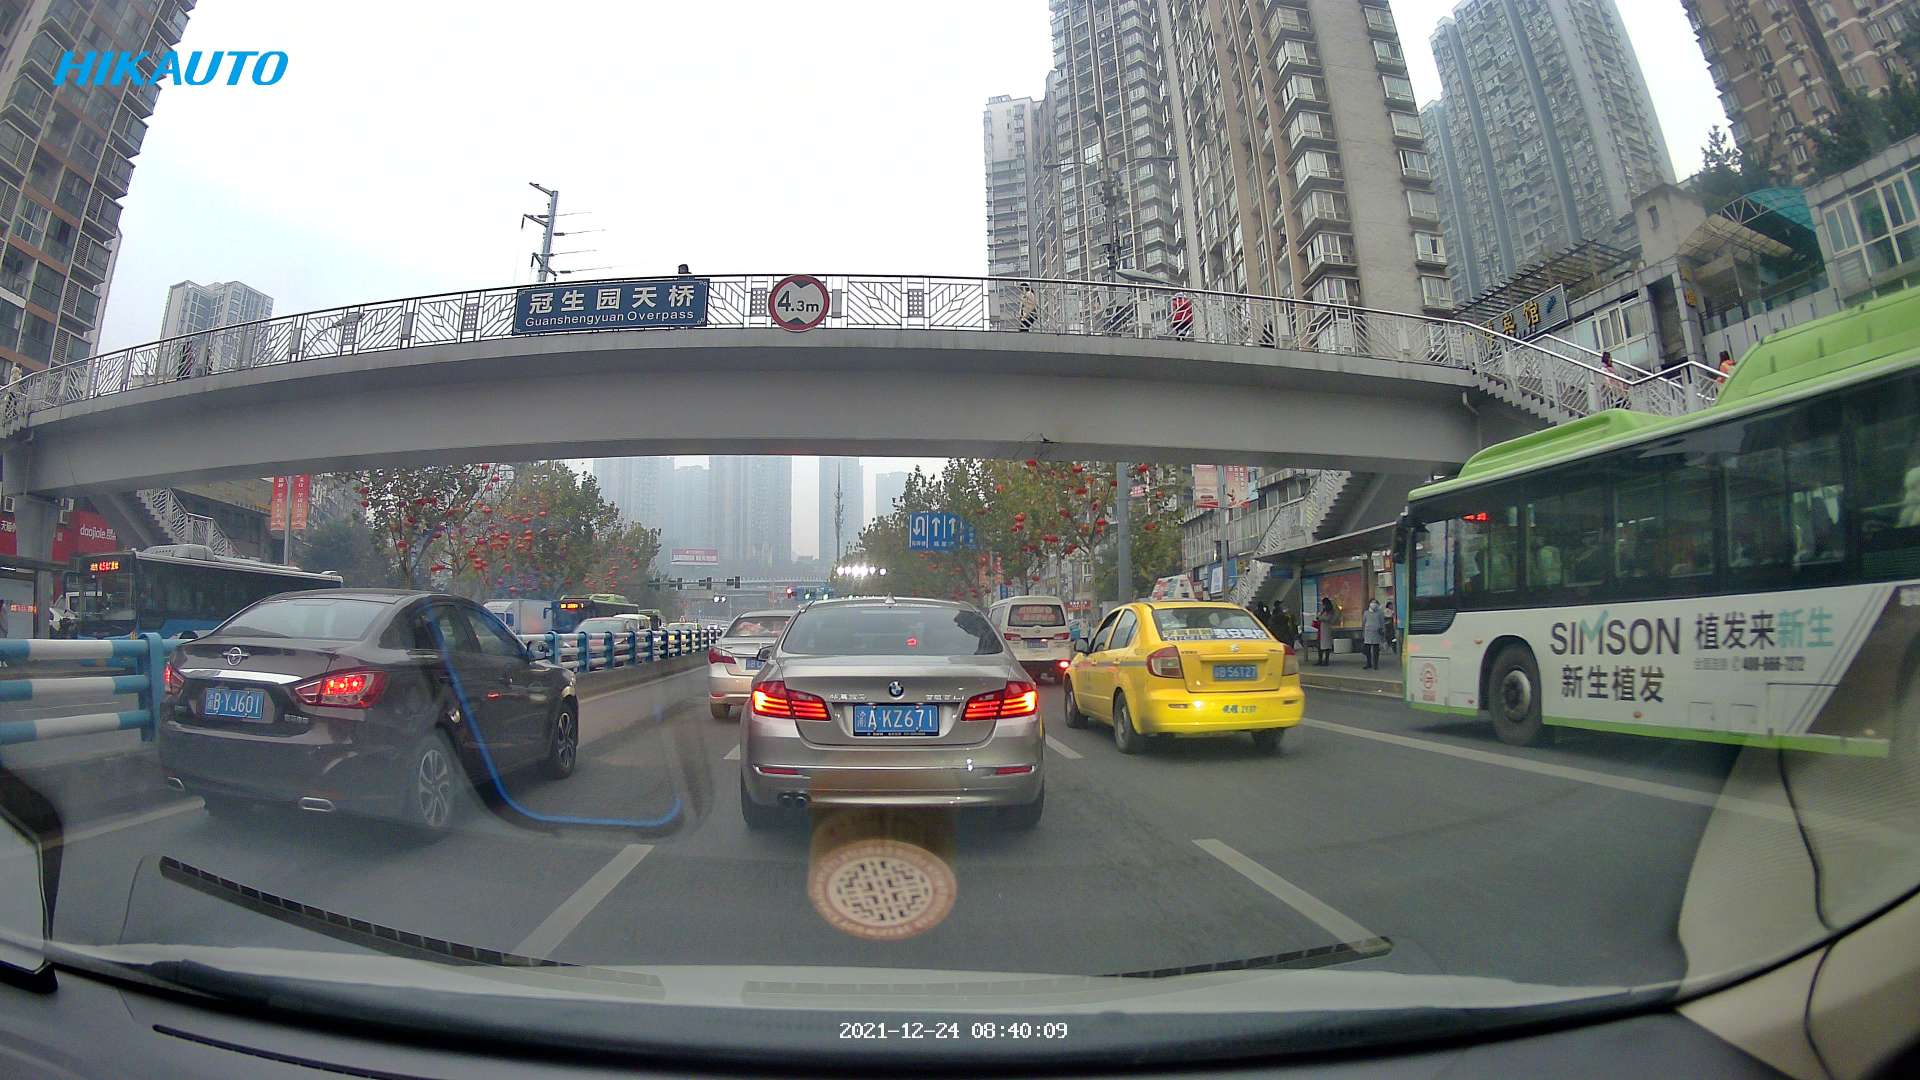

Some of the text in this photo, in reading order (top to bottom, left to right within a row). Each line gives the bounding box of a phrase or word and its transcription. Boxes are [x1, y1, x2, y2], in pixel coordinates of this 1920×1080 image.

[529, 284, 695, 314] 冠生园天桥
[778, 290, 819, 312] 4.3m
[525, 310, 694, 327] Guanshengyuan Overpass
[1550, 610, 1681, 656] SIMSON
[1695, 606, 1834, 651] 植发来新生
[1561, 664, 1665, 703] 新生植发
